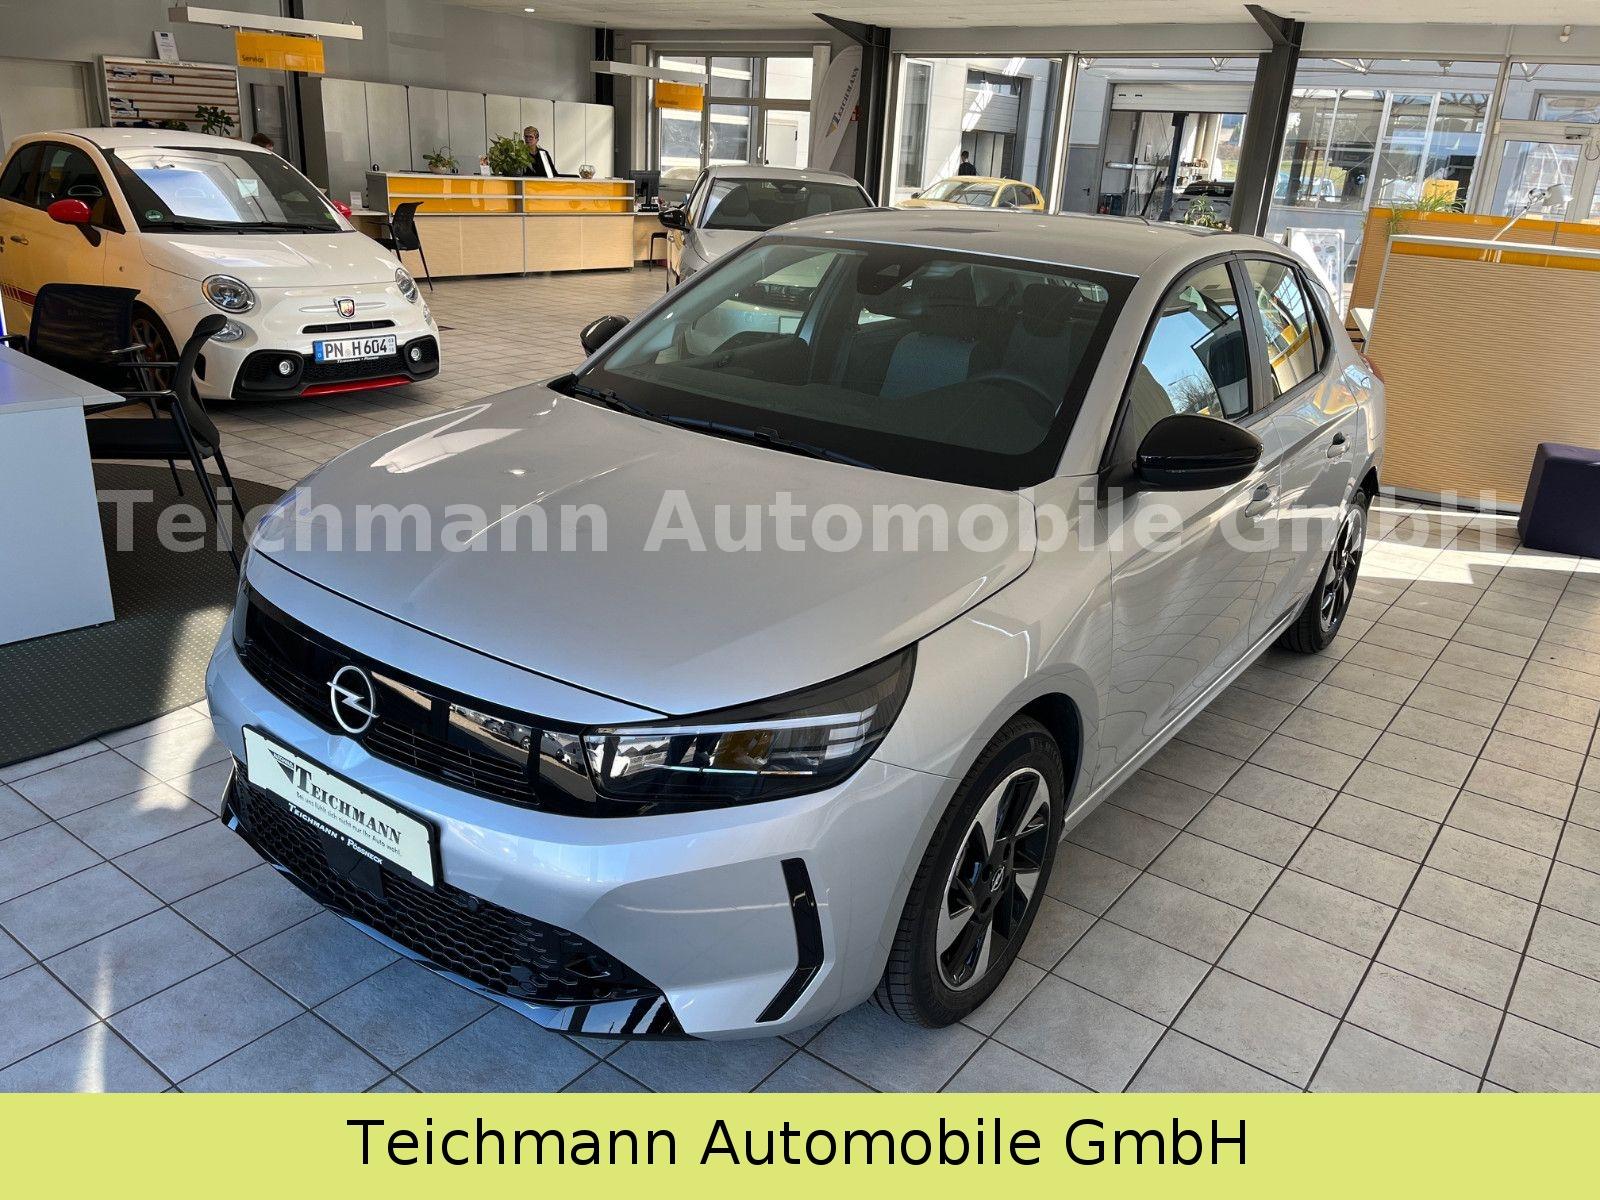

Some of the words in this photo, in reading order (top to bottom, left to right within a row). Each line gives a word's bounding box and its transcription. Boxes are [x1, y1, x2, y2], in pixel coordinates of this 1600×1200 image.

[324, 342, 344, 359] PN
[352, 341, 362, 357] H
[363, 338, 388, 355] 604
[288, 802, 338, 839] TEICHMANN
[295, 764, 401, 845] TEICHMANN
